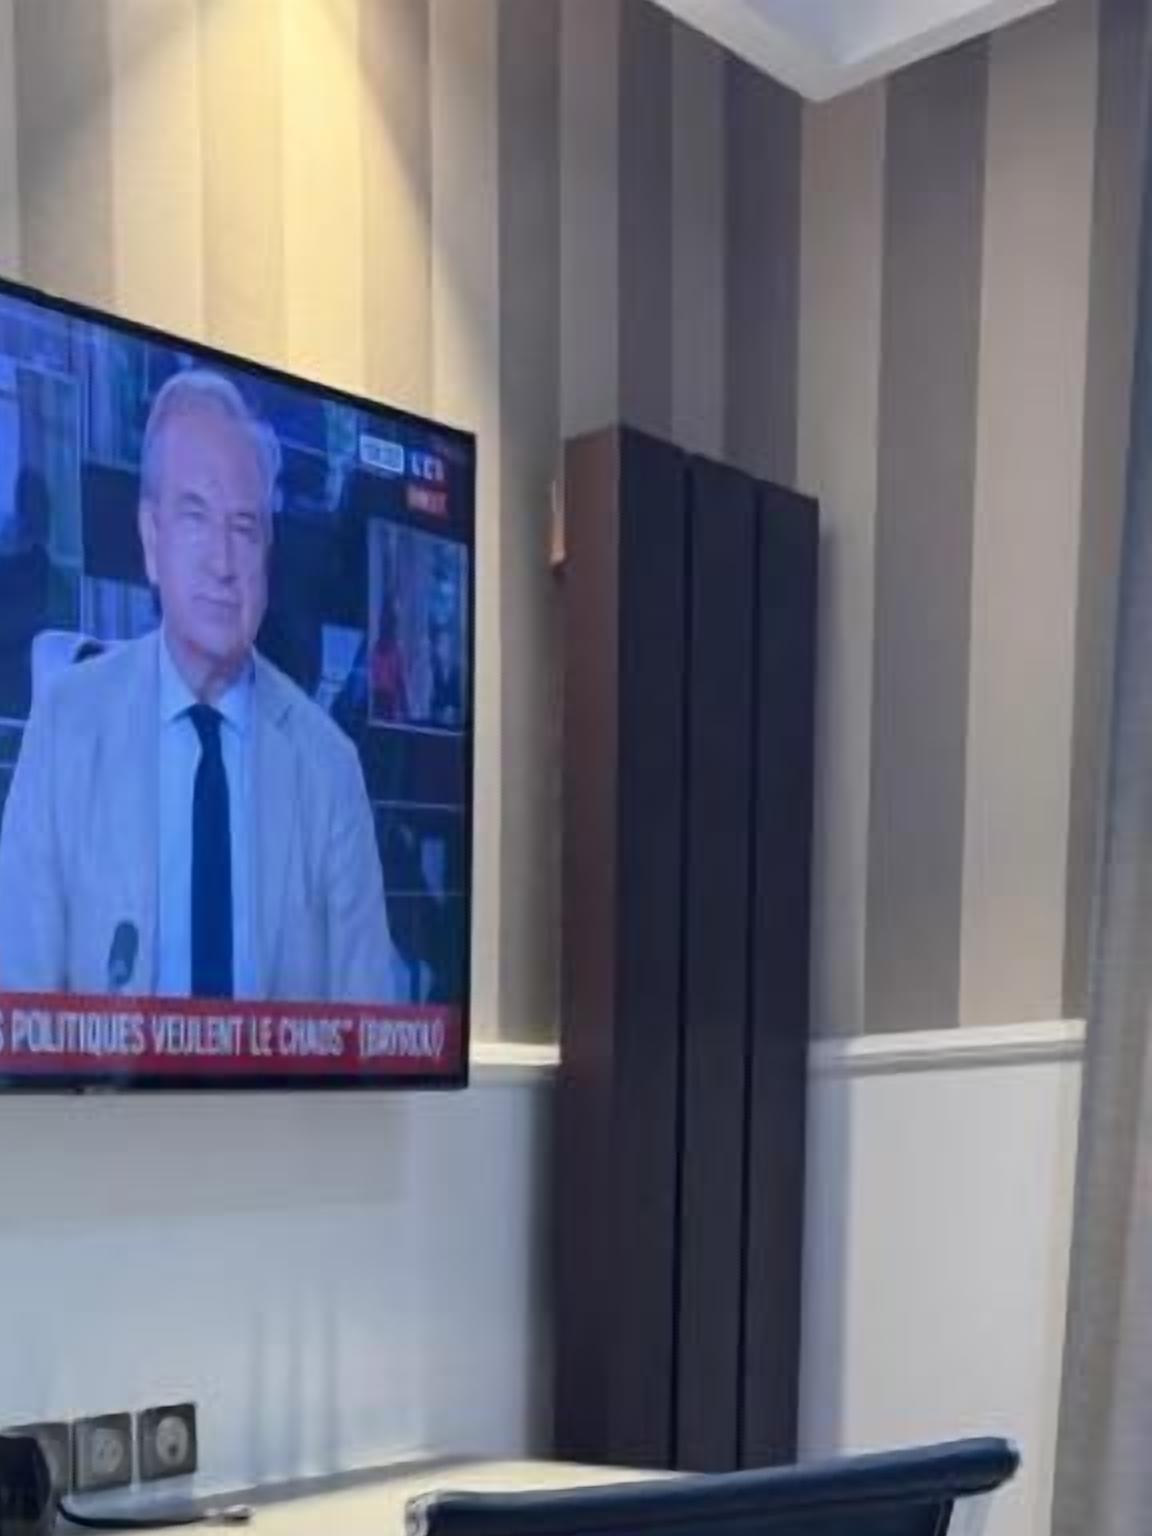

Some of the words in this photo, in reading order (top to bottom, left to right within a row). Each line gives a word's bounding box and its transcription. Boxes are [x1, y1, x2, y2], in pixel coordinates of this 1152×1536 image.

[11, 1009, 145, 1055] POLITIQUES
[152, 1012, 244, 1057] VEULENT
[251, 1014, 273, 1057] LE
